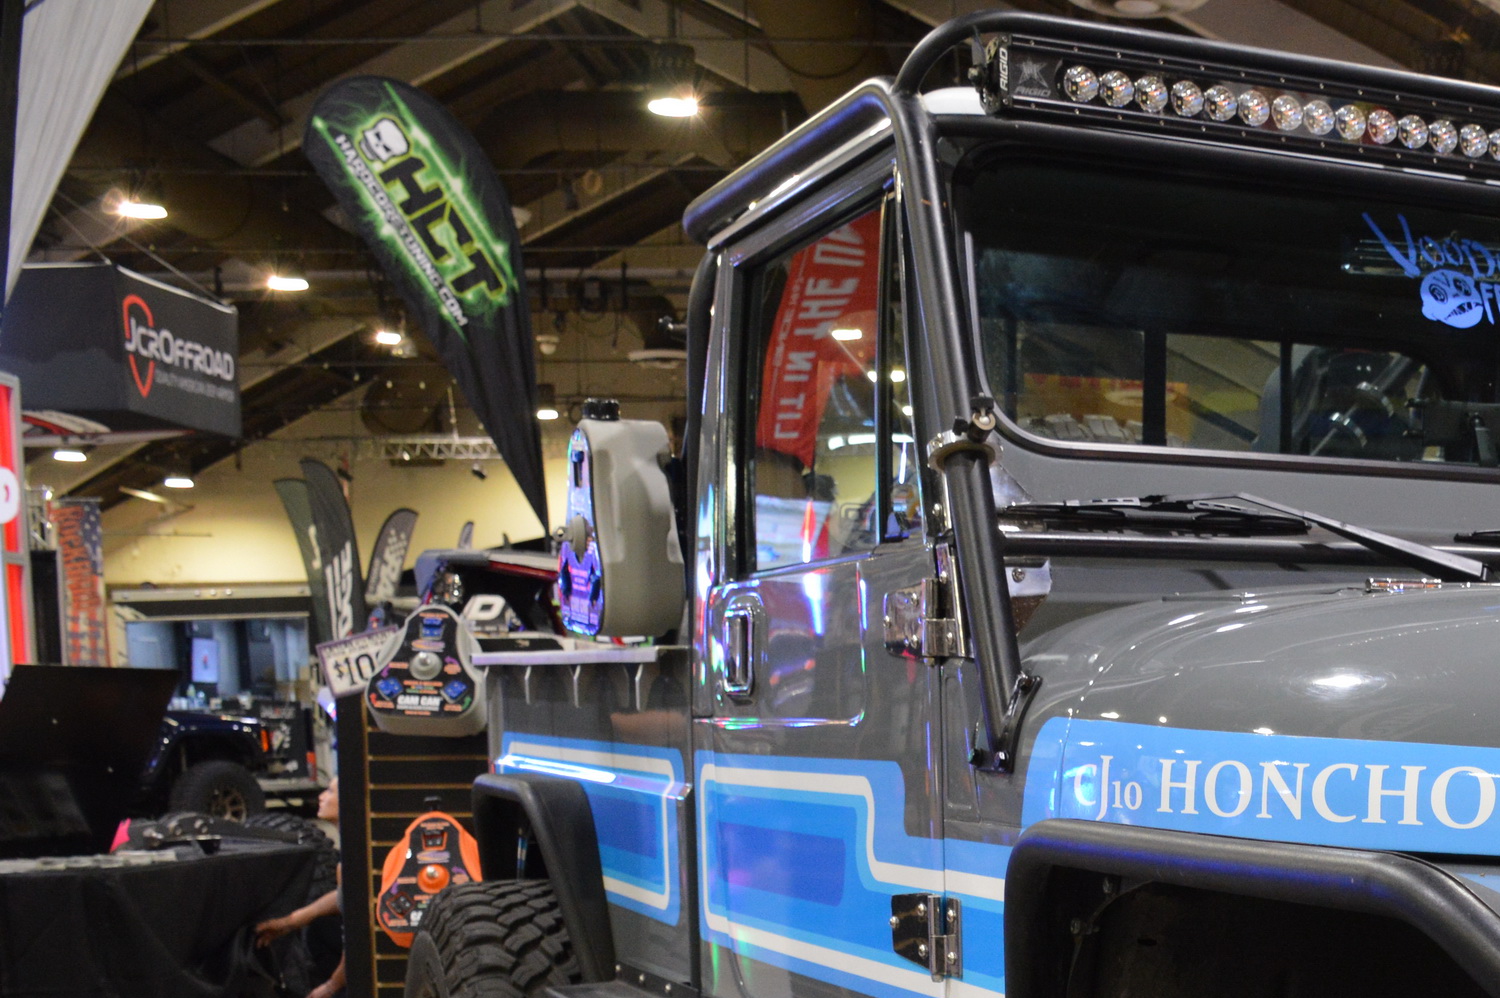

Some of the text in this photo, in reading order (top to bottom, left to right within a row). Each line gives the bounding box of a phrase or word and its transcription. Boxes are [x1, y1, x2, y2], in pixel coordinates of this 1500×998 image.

[999, 47, 1009, 91] RIGID
[377, 154, 506, 299] HCT
[333, 651, 381, 687] $10
[1072, 754, 1498, 831] CJ10 HONCHO
